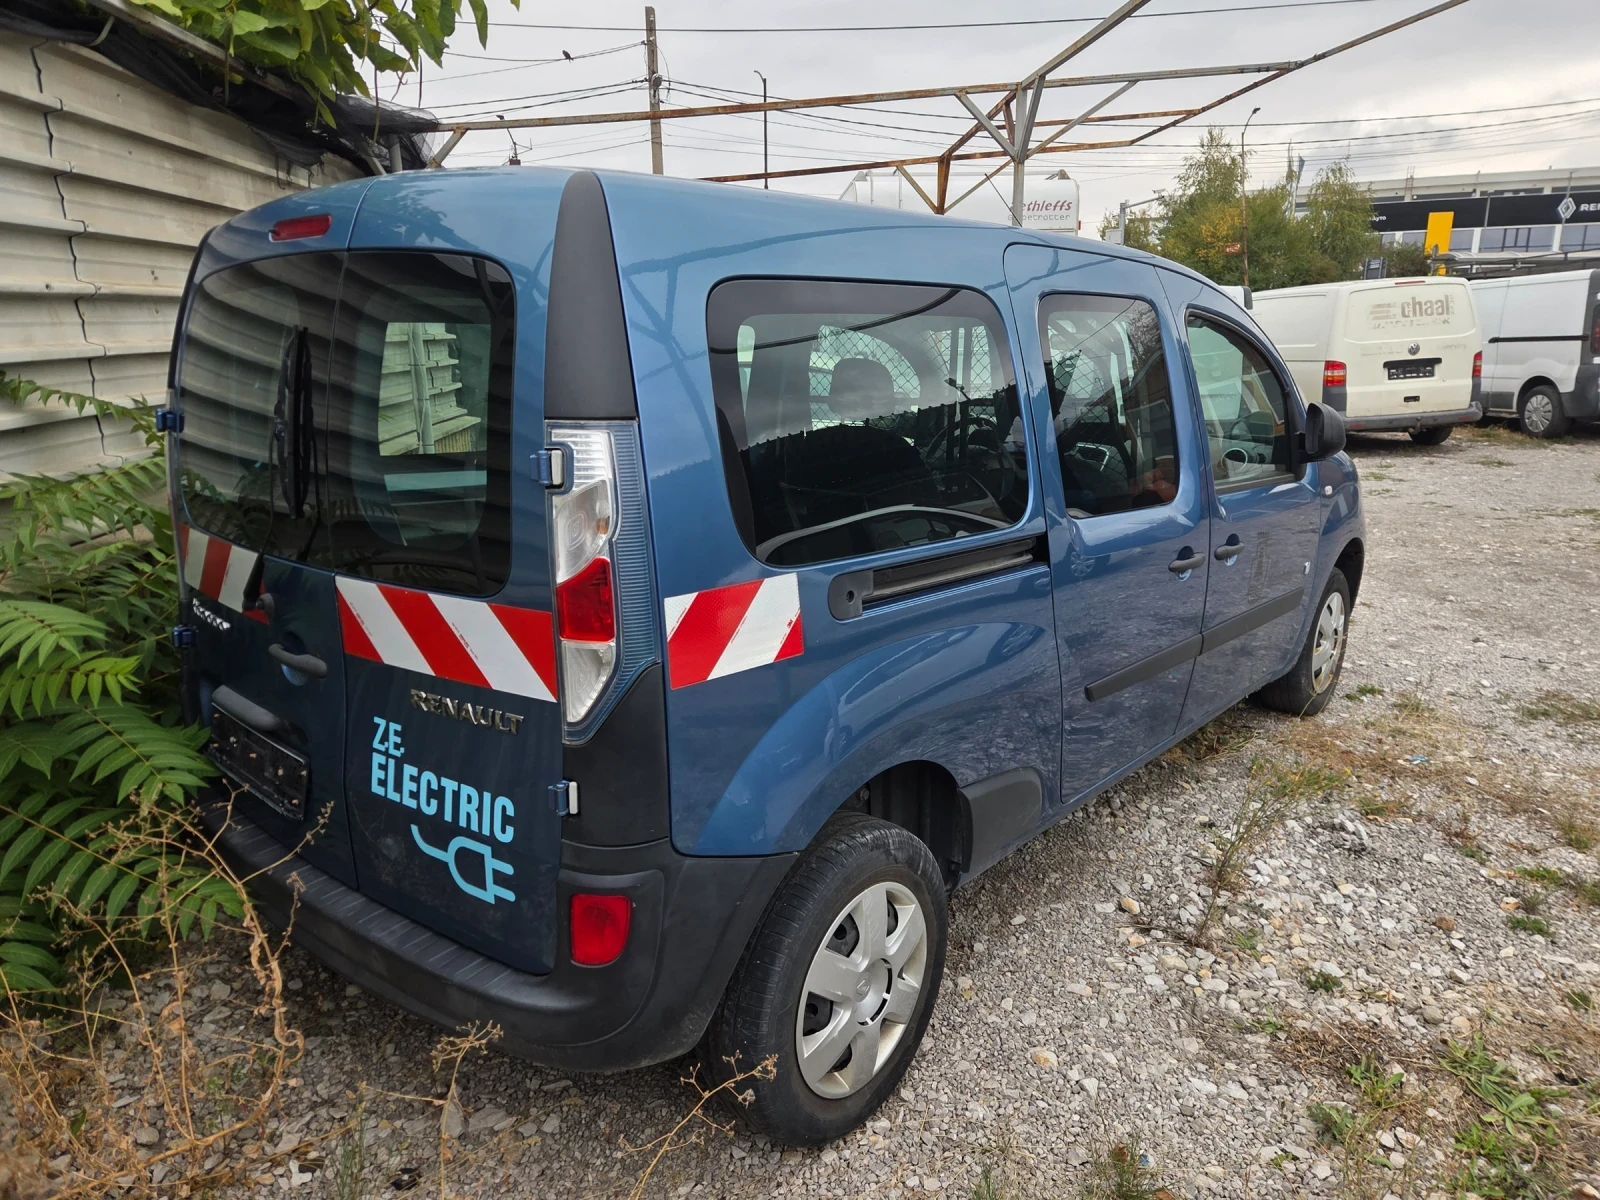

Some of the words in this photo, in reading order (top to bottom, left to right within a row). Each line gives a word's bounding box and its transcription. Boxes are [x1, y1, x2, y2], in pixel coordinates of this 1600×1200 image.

[1010, 200, 1072, 211] ethleffs
[410, 688, 524, 735] RENAULT
[371, 751, 515, 844] ELECTRIC
